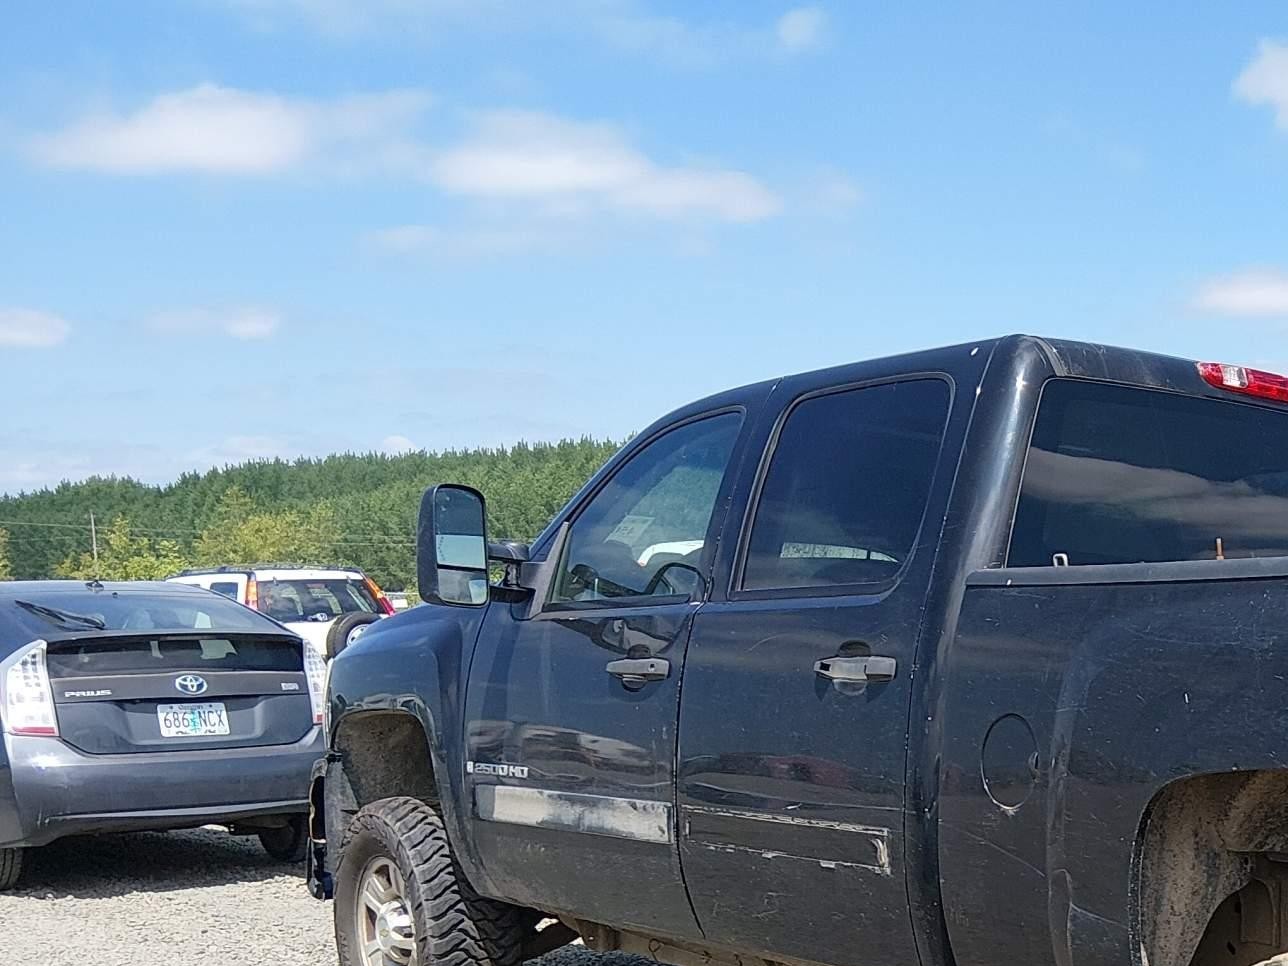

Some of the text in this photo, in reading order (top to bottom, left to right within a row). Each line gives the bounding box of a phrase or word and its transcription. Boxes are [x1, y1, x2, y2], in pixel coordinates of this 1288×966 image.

[64, 689, 113, 698] PRIUS
[163, 710, 225, 728] 686 NCX
[475, 763, 509, 776] 2500
[509, 765, 529, 778] HD
